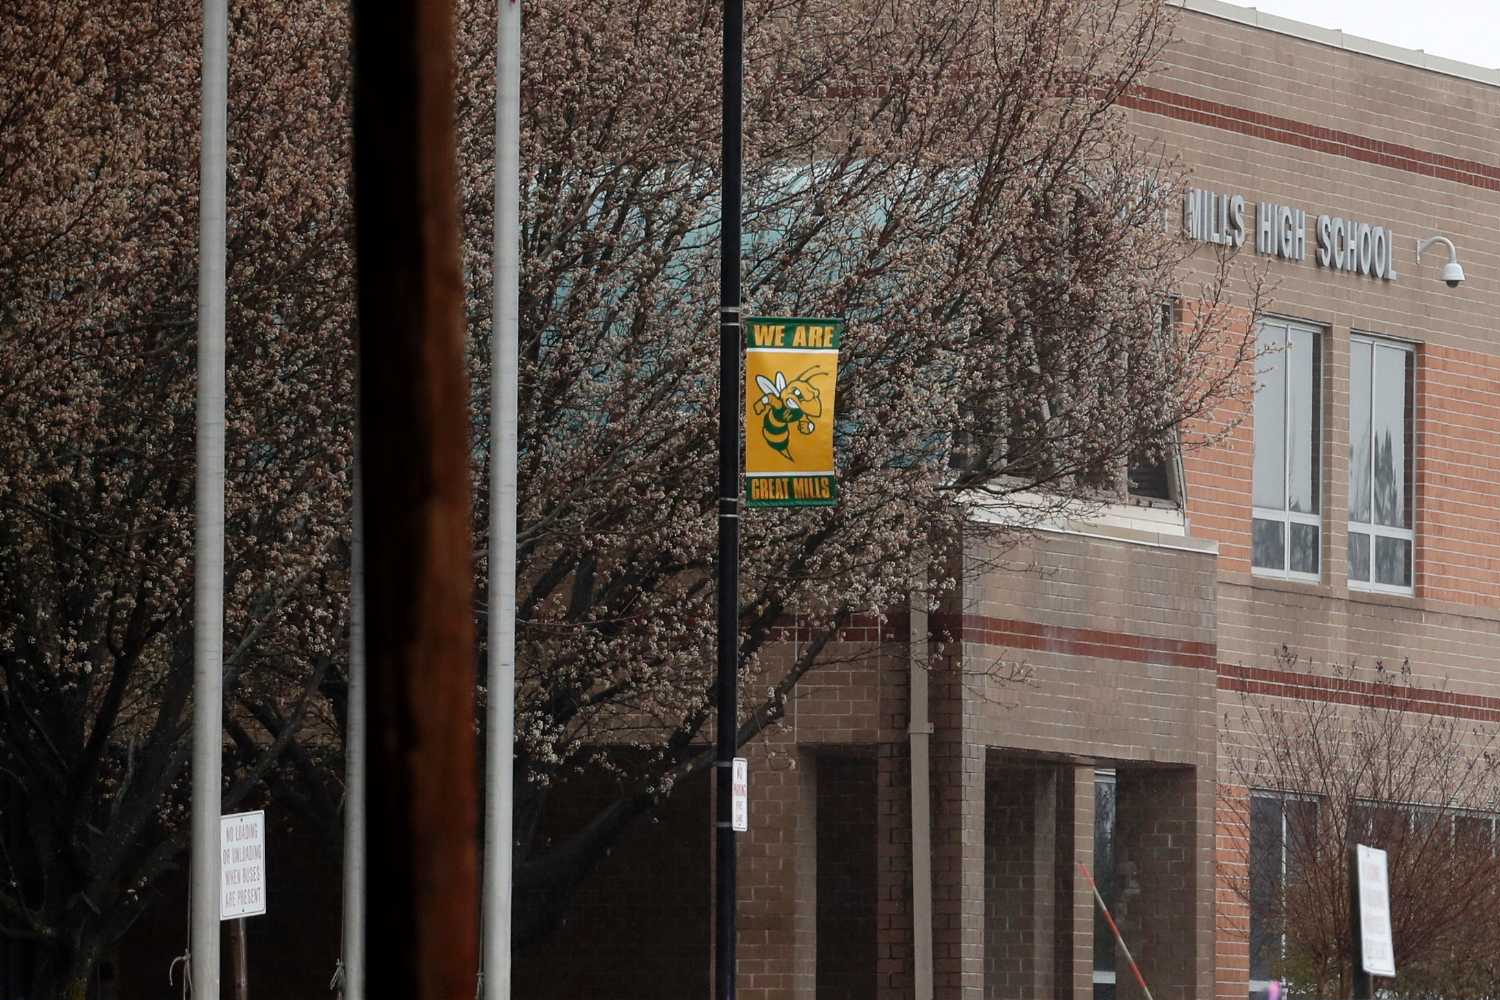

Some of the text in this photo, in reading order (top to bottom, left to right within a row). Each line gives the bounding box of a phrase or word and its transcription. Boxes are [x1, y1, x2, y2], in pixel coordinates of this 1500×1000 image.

[1184, 187, 1397, 280] MILLS HIGH SCHOOL
[754, 325, 835, 348] WE ARE
[752, 477, 830, 500] GREAT MILLS
